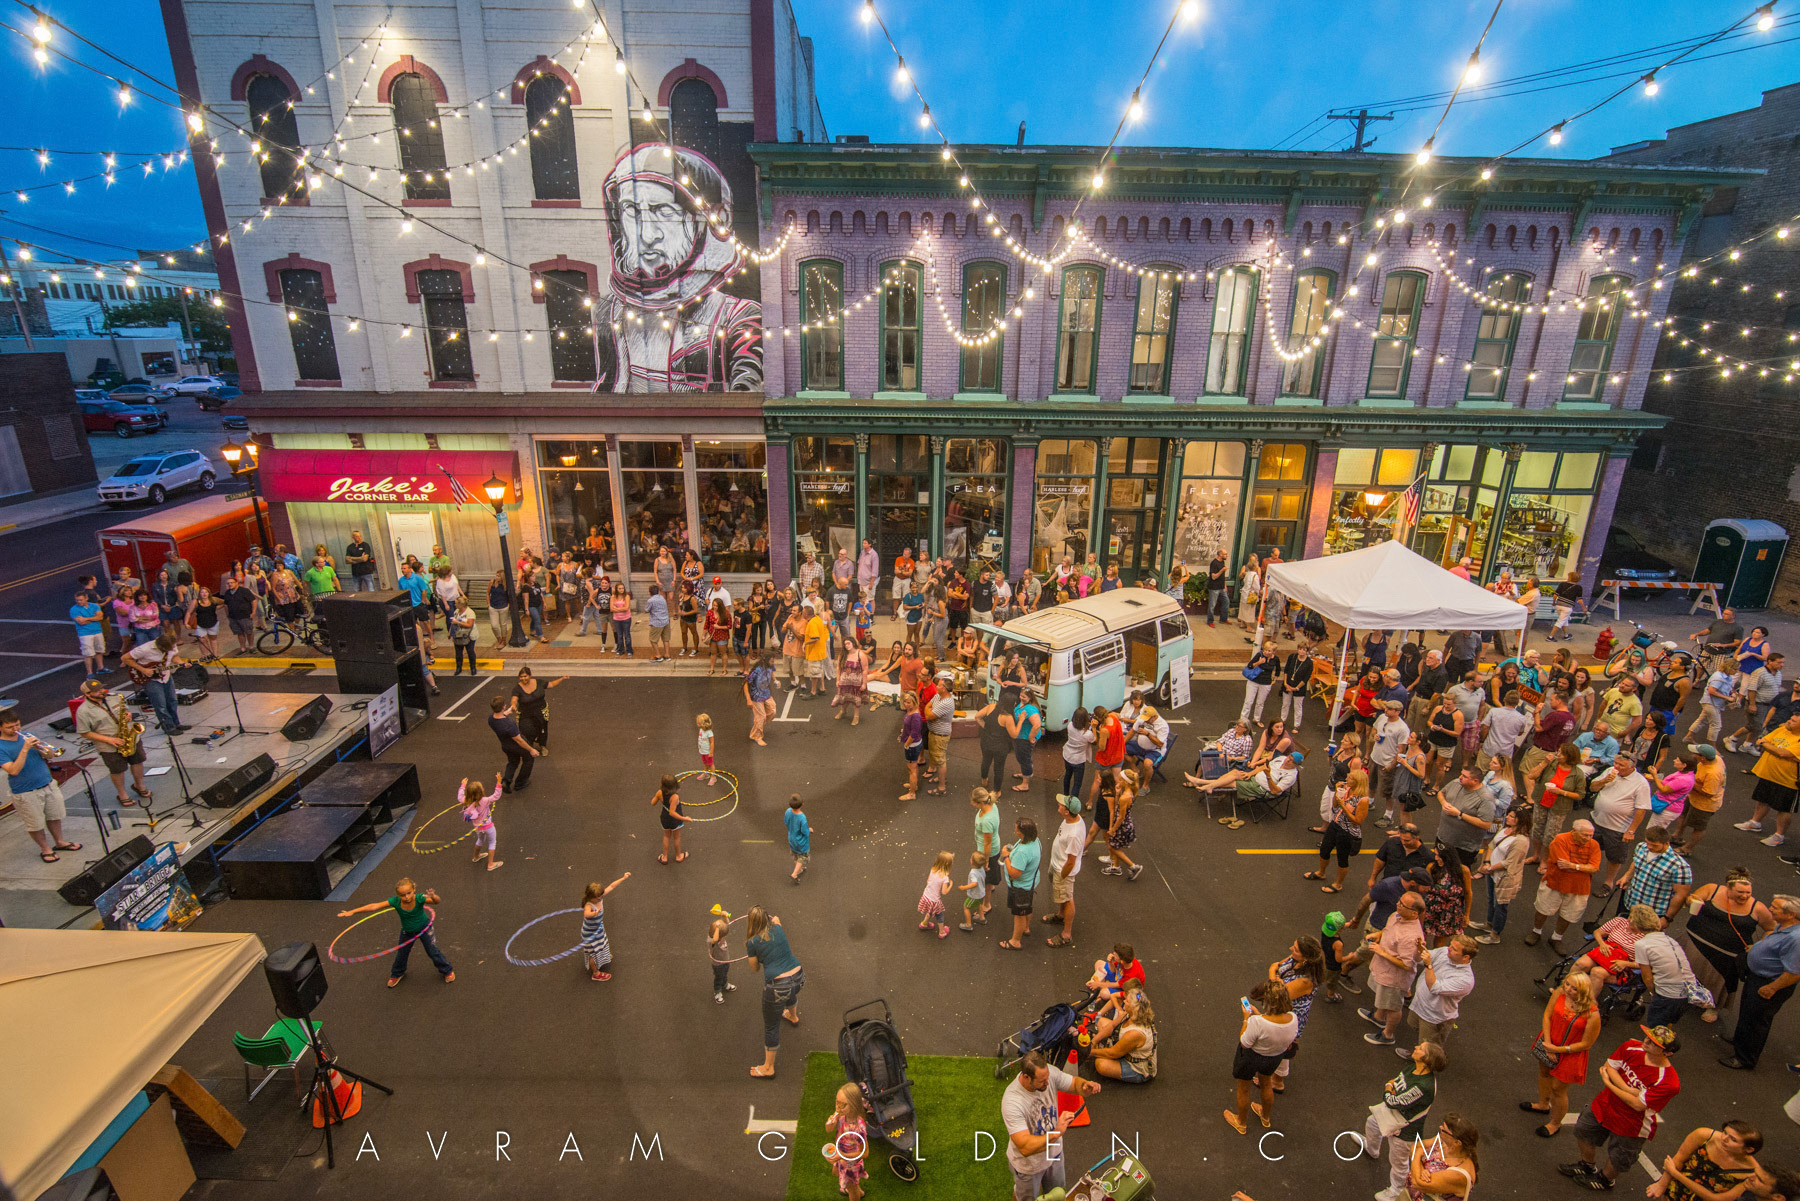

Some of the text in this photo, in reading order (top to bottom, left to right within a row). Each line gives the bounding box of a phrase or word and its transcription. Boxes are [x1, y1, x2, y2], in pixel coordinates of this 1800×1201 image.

[327, 476, 438, 500] Jake's
[953, 485, 996, 493] FLEA
[1189, 487, 1231, 495] FLEA
[344, 493, 430, 501] CORNER BAR
[893, 490, 906, 500] 112
[1333, 515, 1365, 526] Perfectly
[118, 891, 142, 912] STAR
[144, 864, 170, 891] BRIDGE
